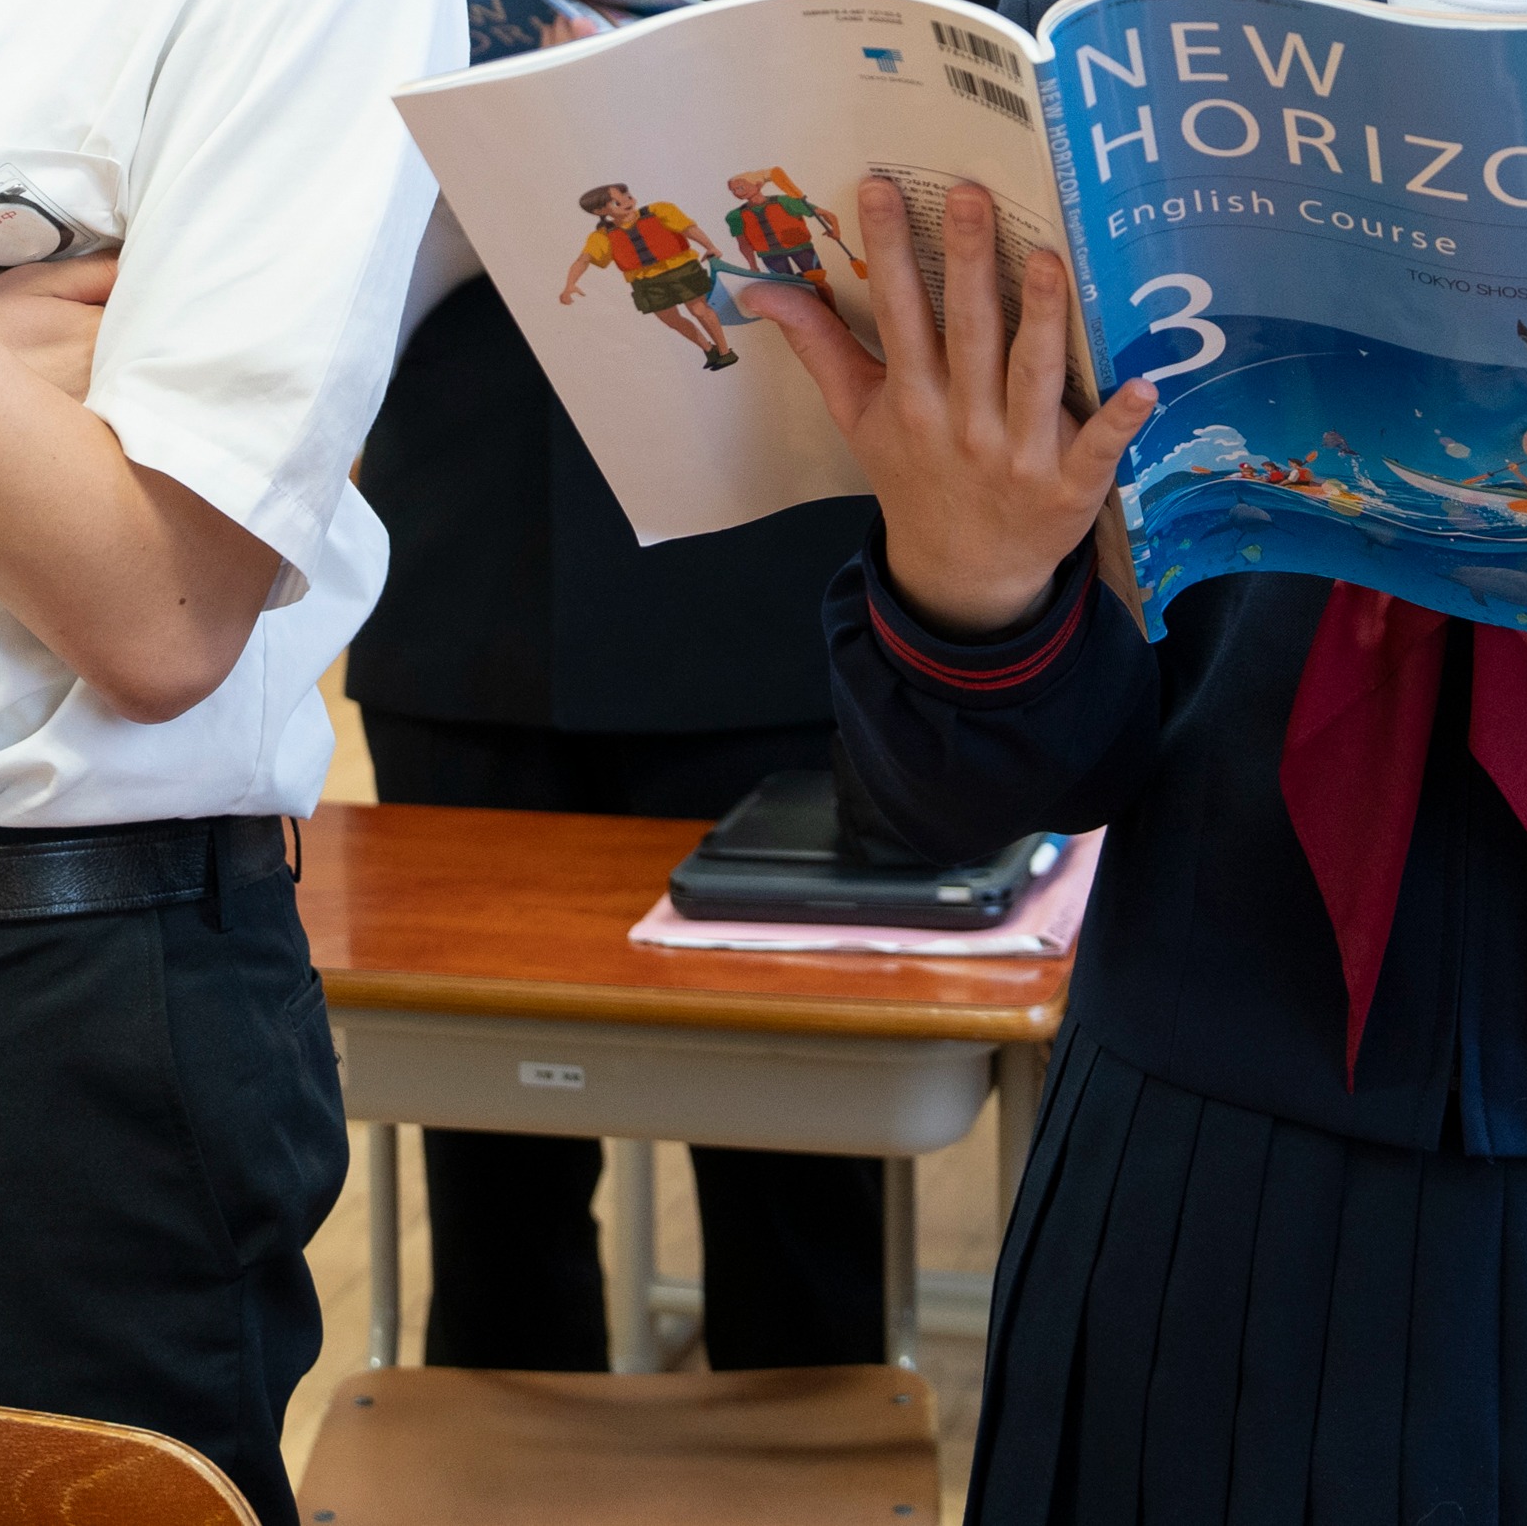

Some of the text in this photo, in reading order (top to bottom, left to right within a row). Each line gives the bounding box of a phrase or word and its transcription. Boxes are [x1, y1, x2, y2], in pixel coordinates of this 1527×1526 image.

[1038, 77, 1065, 120] NEW
[1076, 22, 1345, 109] NEW
[1048, 123, 1082, 206] HORIZON
[1108, 188, 1459, 256] English Course
[1082, 284, 1099, 303] 3
[1405, 268, 1471, 294] TOKYO
[1129, 273, 1226, 383] 3
